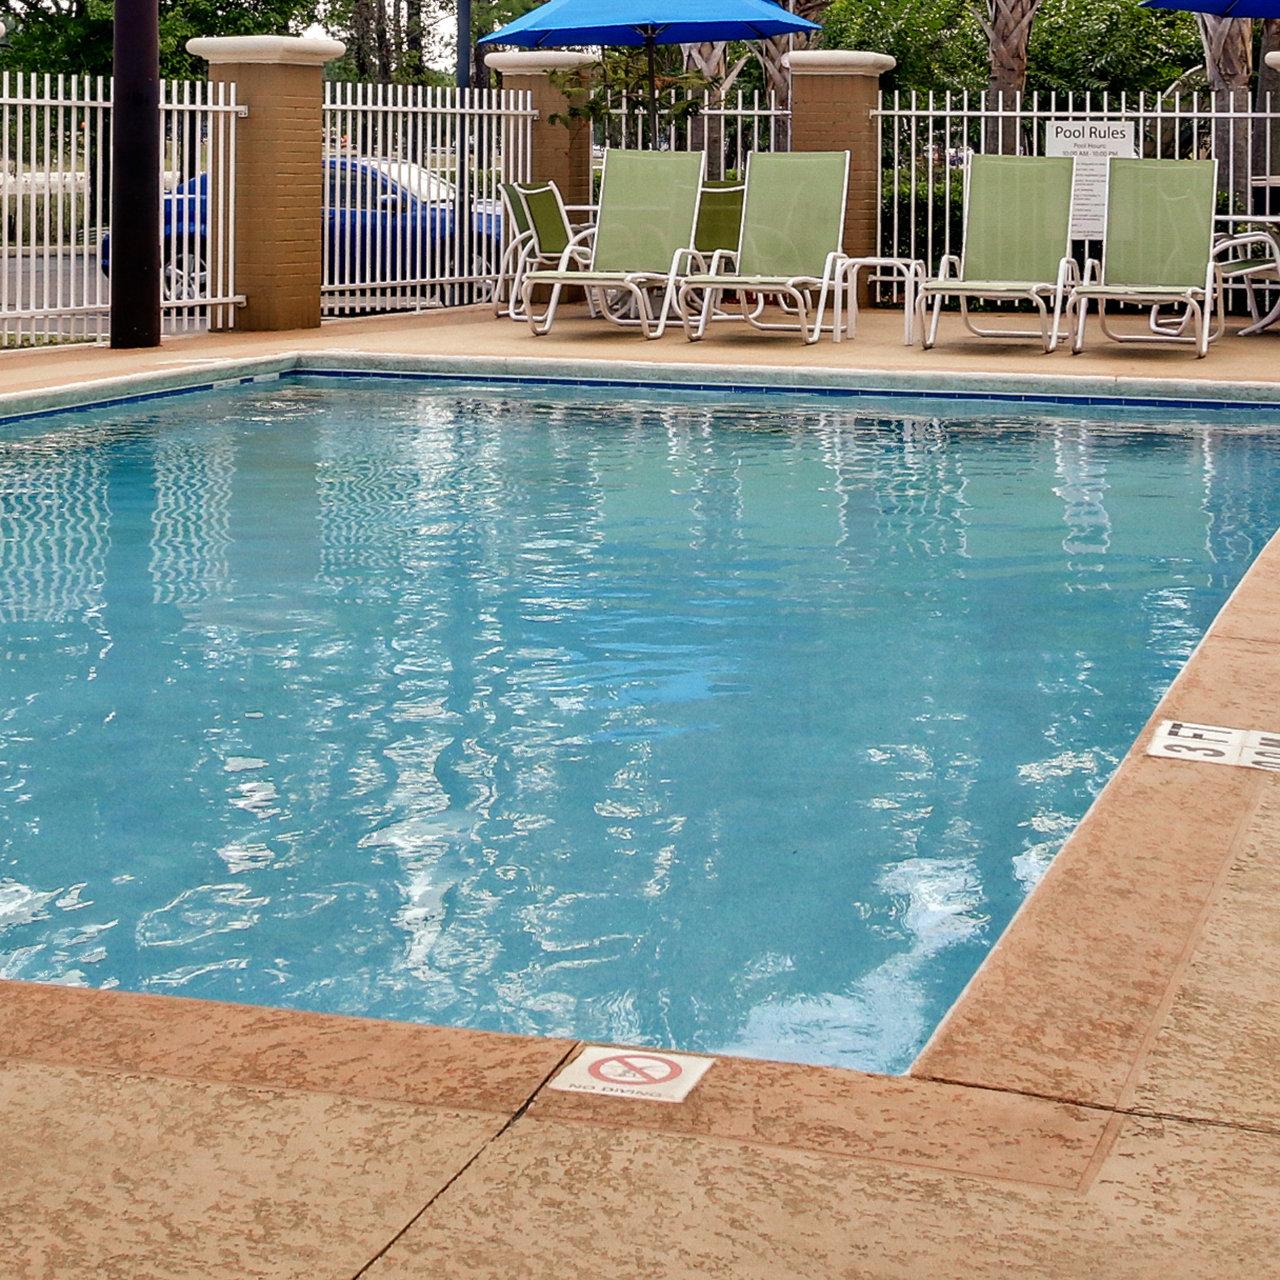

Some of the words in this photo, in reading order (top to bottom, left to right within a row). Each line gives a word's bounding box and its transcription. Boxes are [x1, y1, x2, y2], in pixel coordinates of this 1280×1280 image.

[1055, 125, 1085, 139] Pool
[1089, 125, 1126, 139] Rules
[1167, 722, 1233, 744] FT
[1163, 743, 1226, 758] 3
[602, 1086, 662, 1098] DIVING
